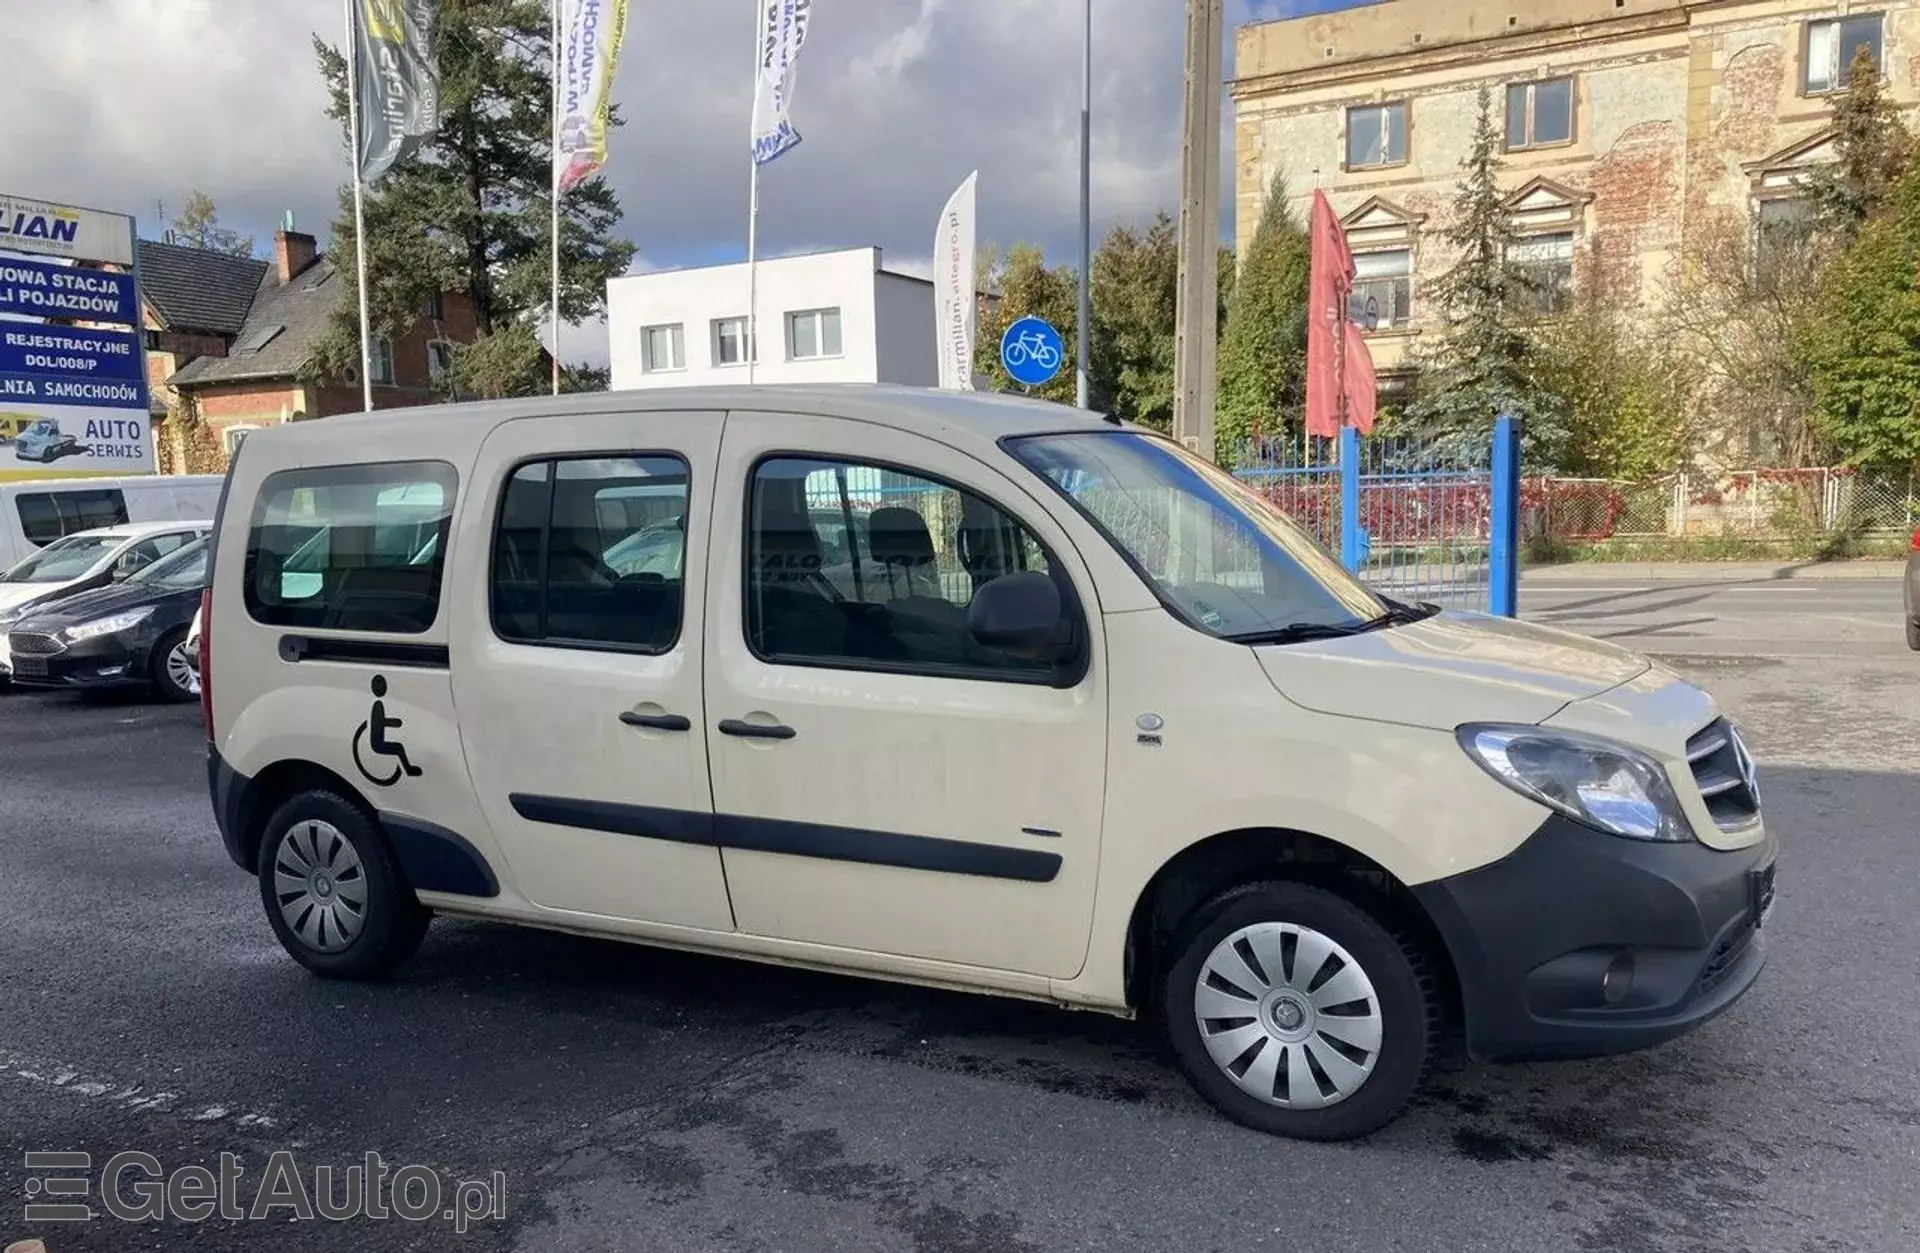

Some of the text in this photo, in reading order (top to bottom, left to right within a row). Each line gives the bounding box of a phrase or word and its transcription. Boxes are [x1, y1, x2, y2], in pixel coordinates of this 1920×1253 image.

[52, 273, 119, 294] STACJA
[19, 289, 119, 313] POJAZDÓW
[5, 332, 130, 355] REJESTRACYJNE
[25, 354, 97, 370] DOL/008/P
[45, 381, 137, 400] SAMOCHODÓW
[86, 418, 141, 440] AUTO
[87, 442, 143, 459] SERWIS
